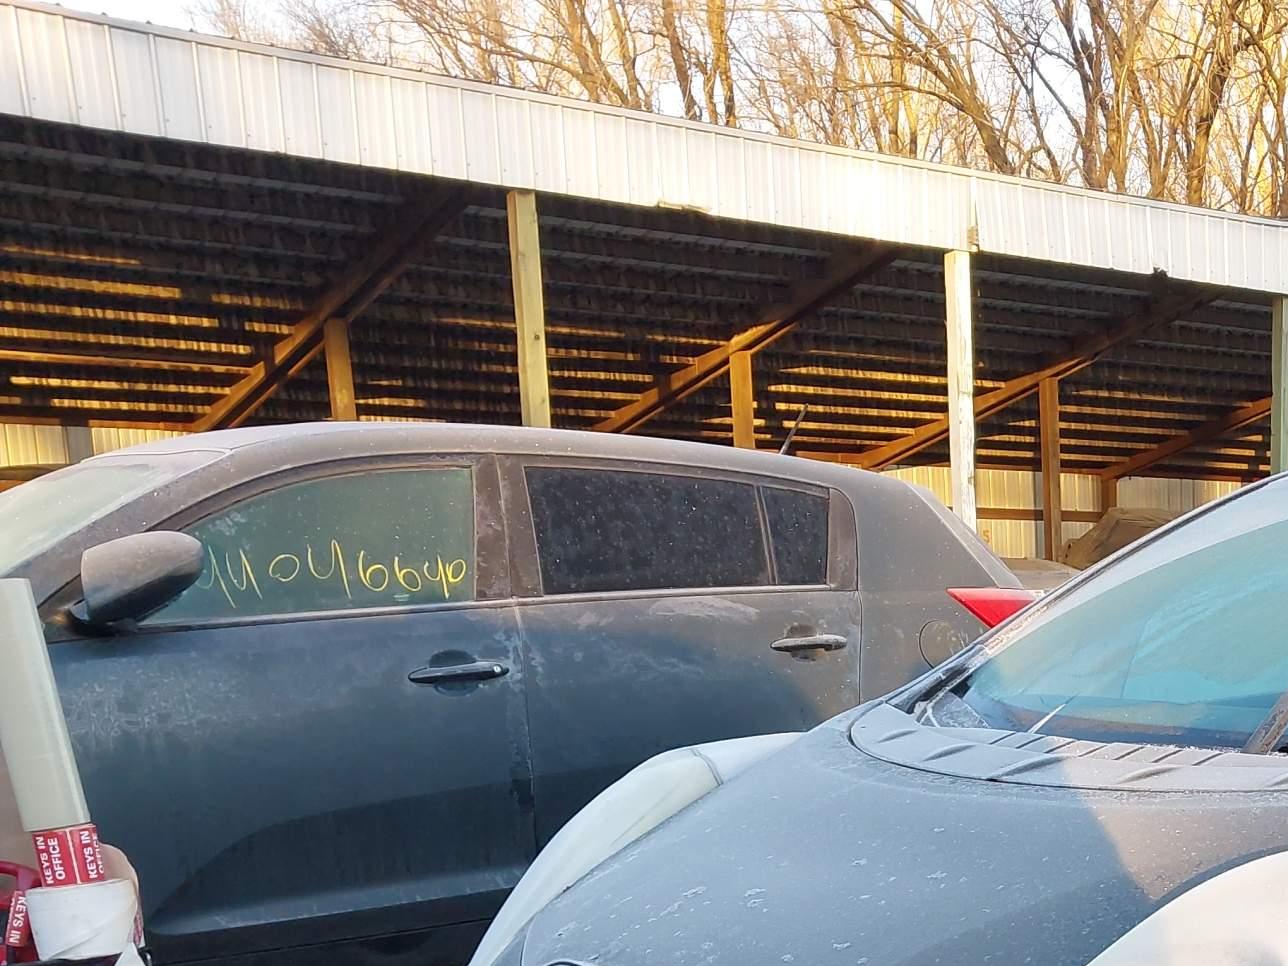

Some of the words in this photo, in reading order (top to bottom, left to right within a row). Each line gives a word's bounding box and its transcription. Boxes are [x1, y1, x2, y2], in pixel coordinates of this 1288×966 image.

[35, 836, 46, 849] IN
[79, 830, 91, 844] IN
[40, 852, 54, 884] KEYS
[47, 838, 66, 880] OFFICE
[83, 847, 98, 878] KEYS
[12, 896, 27, 928] KEYS
[8, 929, 21, 944] IN
